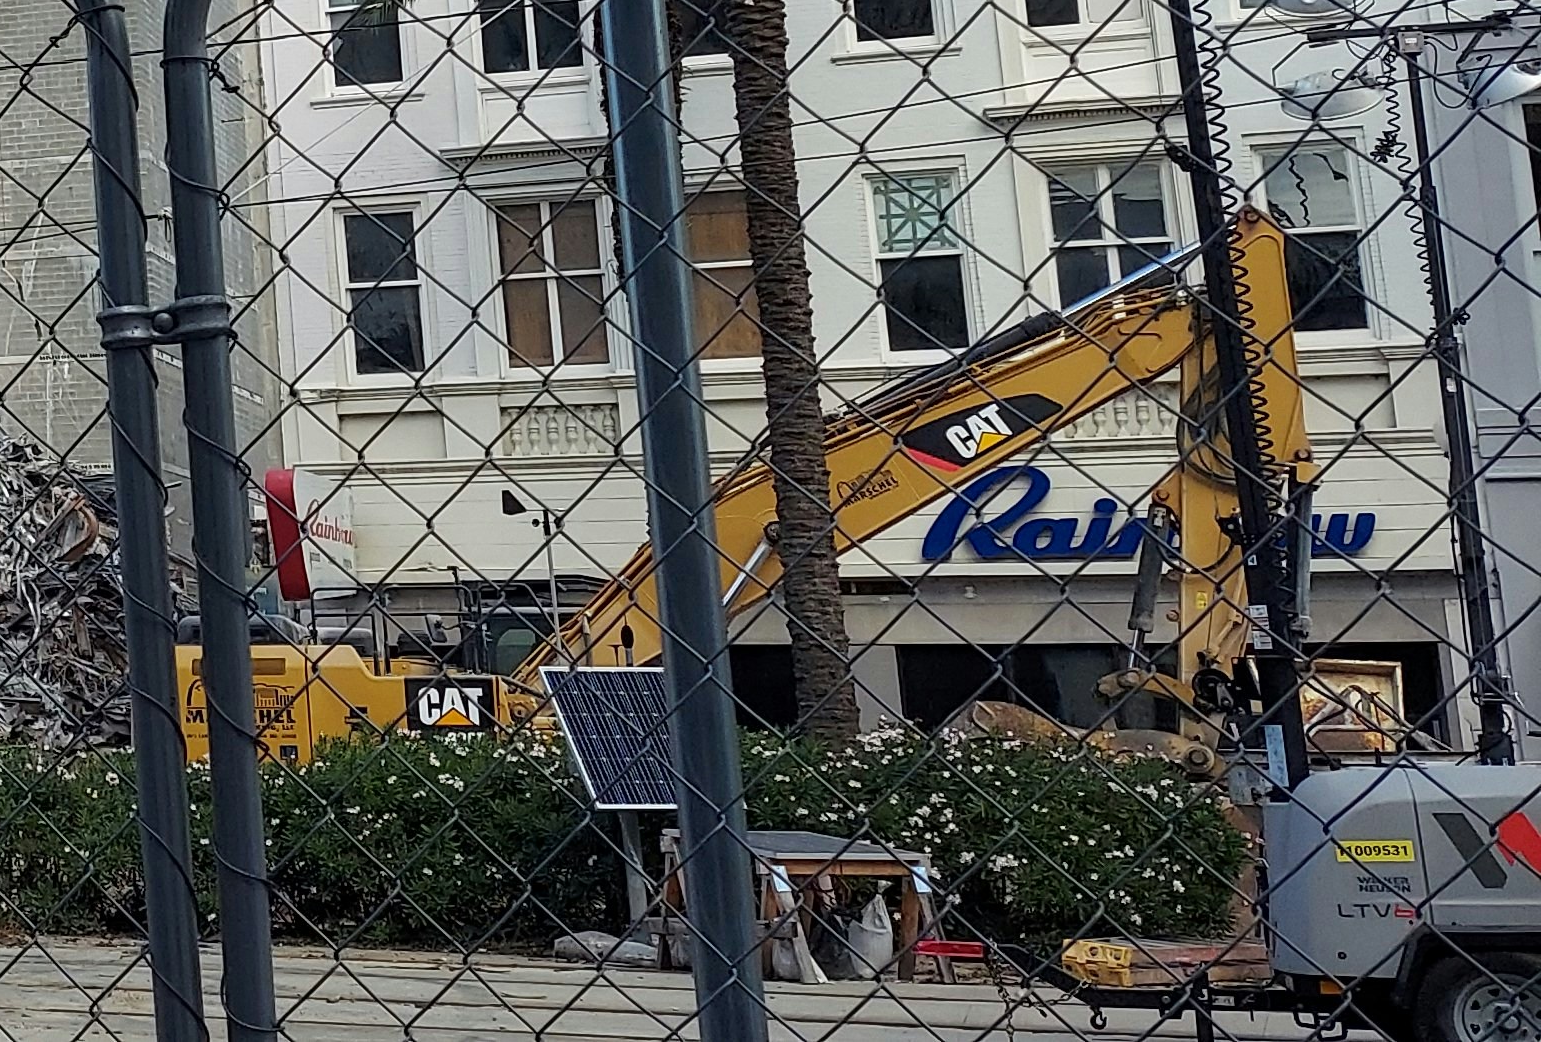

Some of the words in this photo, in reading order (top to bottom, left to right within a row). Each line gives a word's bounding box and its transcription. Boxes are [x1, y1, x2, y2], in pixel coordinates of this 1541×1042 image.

[946, 404, 1013, 459] CAT
[922, 466, 1376, 559] Rainw
[418, 687, 483, 726] CAT
[1357, 876, 1408, 884] WAKER
